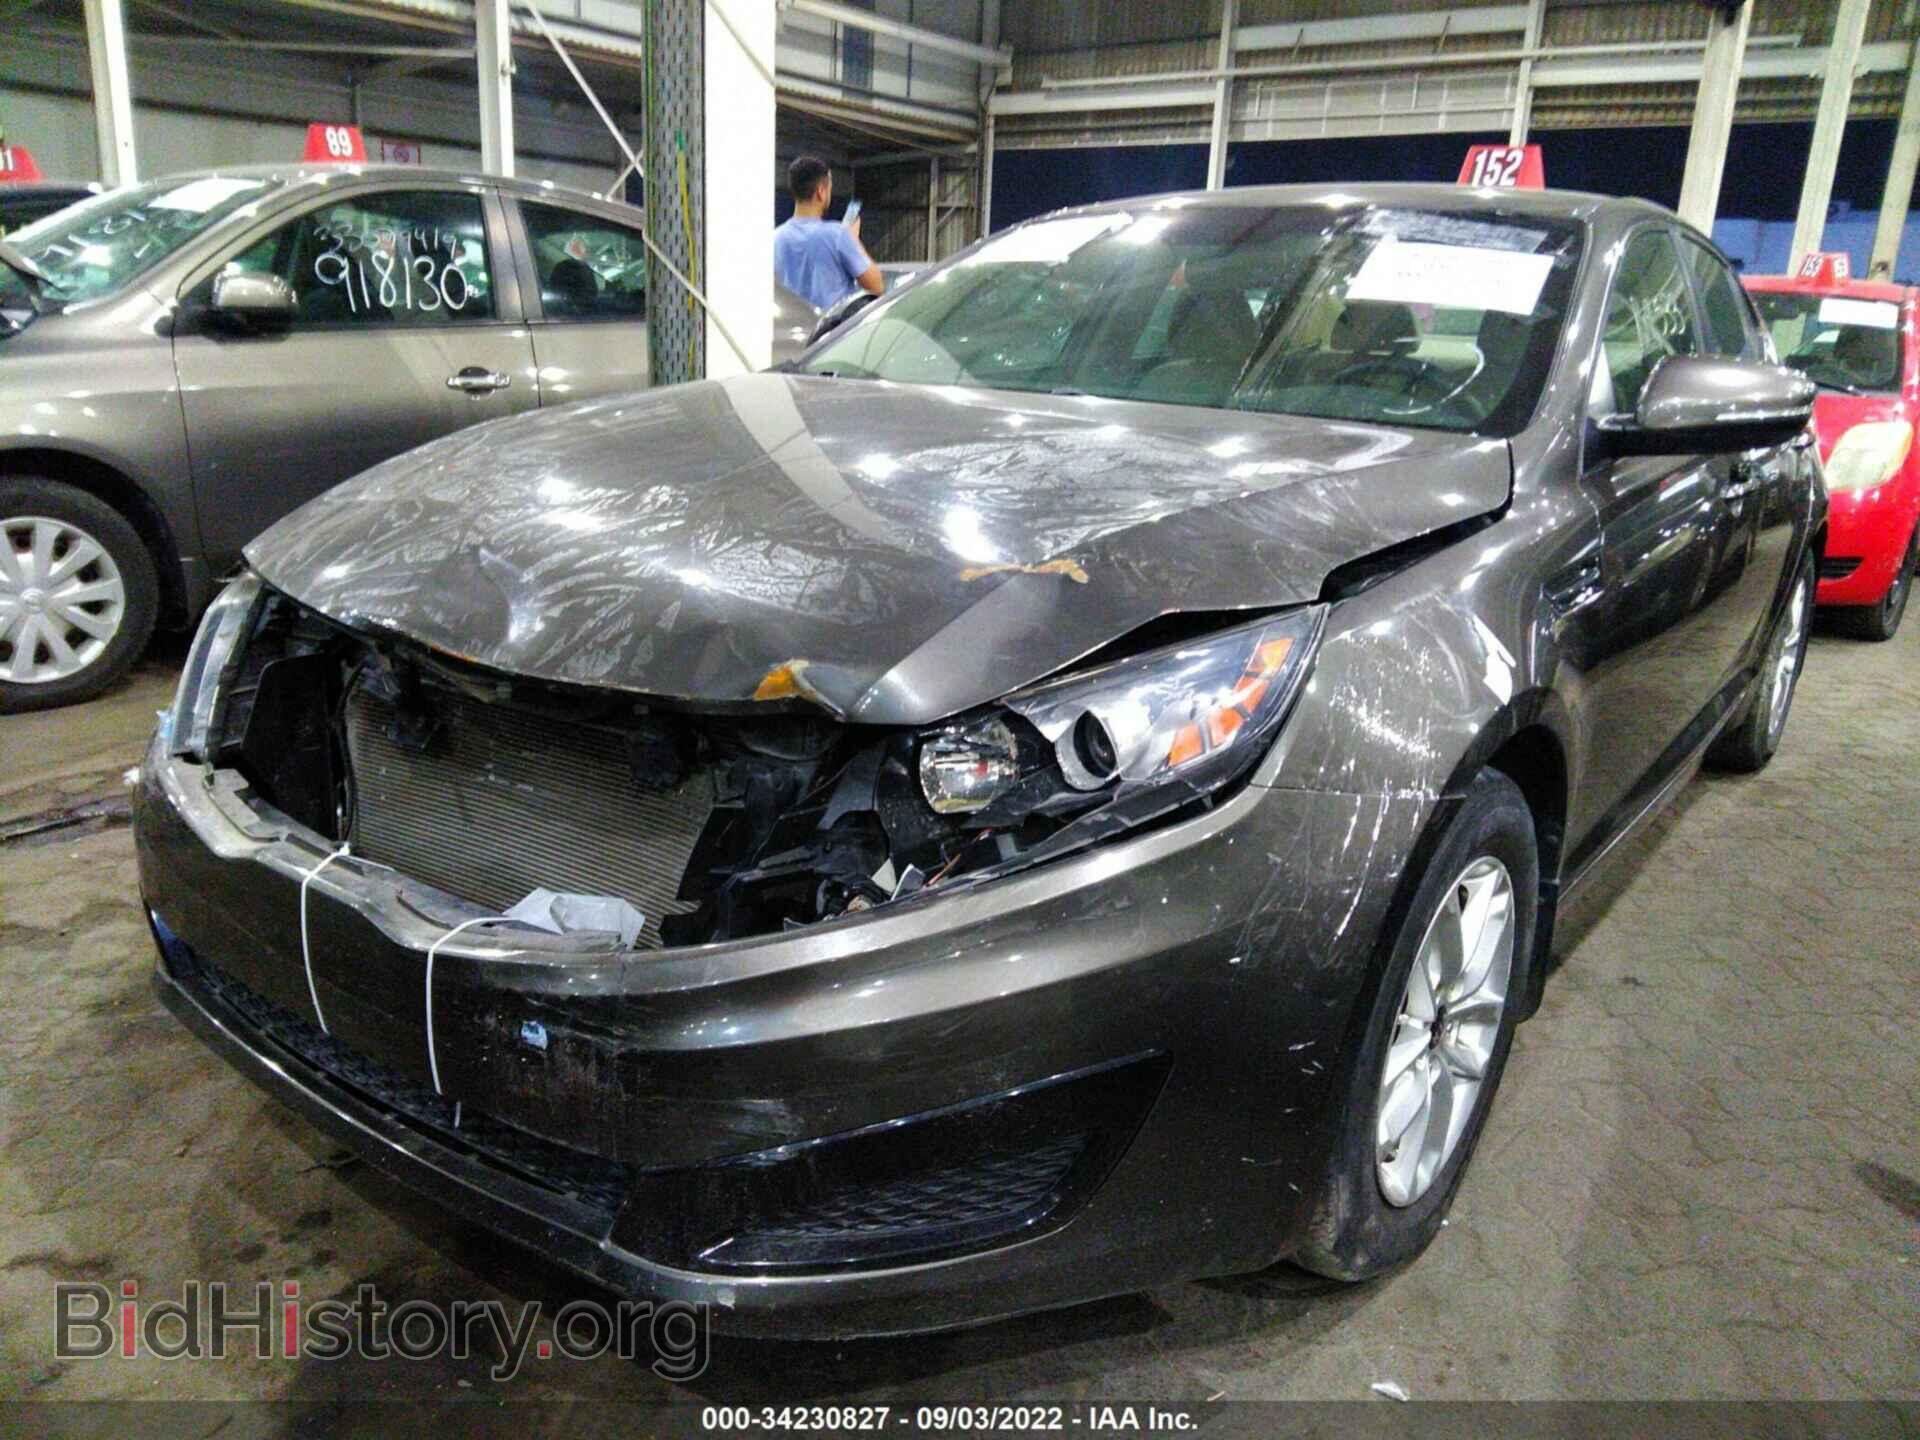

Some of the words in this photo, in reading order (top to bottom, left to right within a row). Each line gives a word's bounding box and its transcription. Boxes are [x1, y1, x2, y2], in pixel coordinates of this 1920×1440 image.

[325, 126, 353, 157] 89
[1471, 147, 1525, 187] 152
[314, 250, 469, 313] 918130
